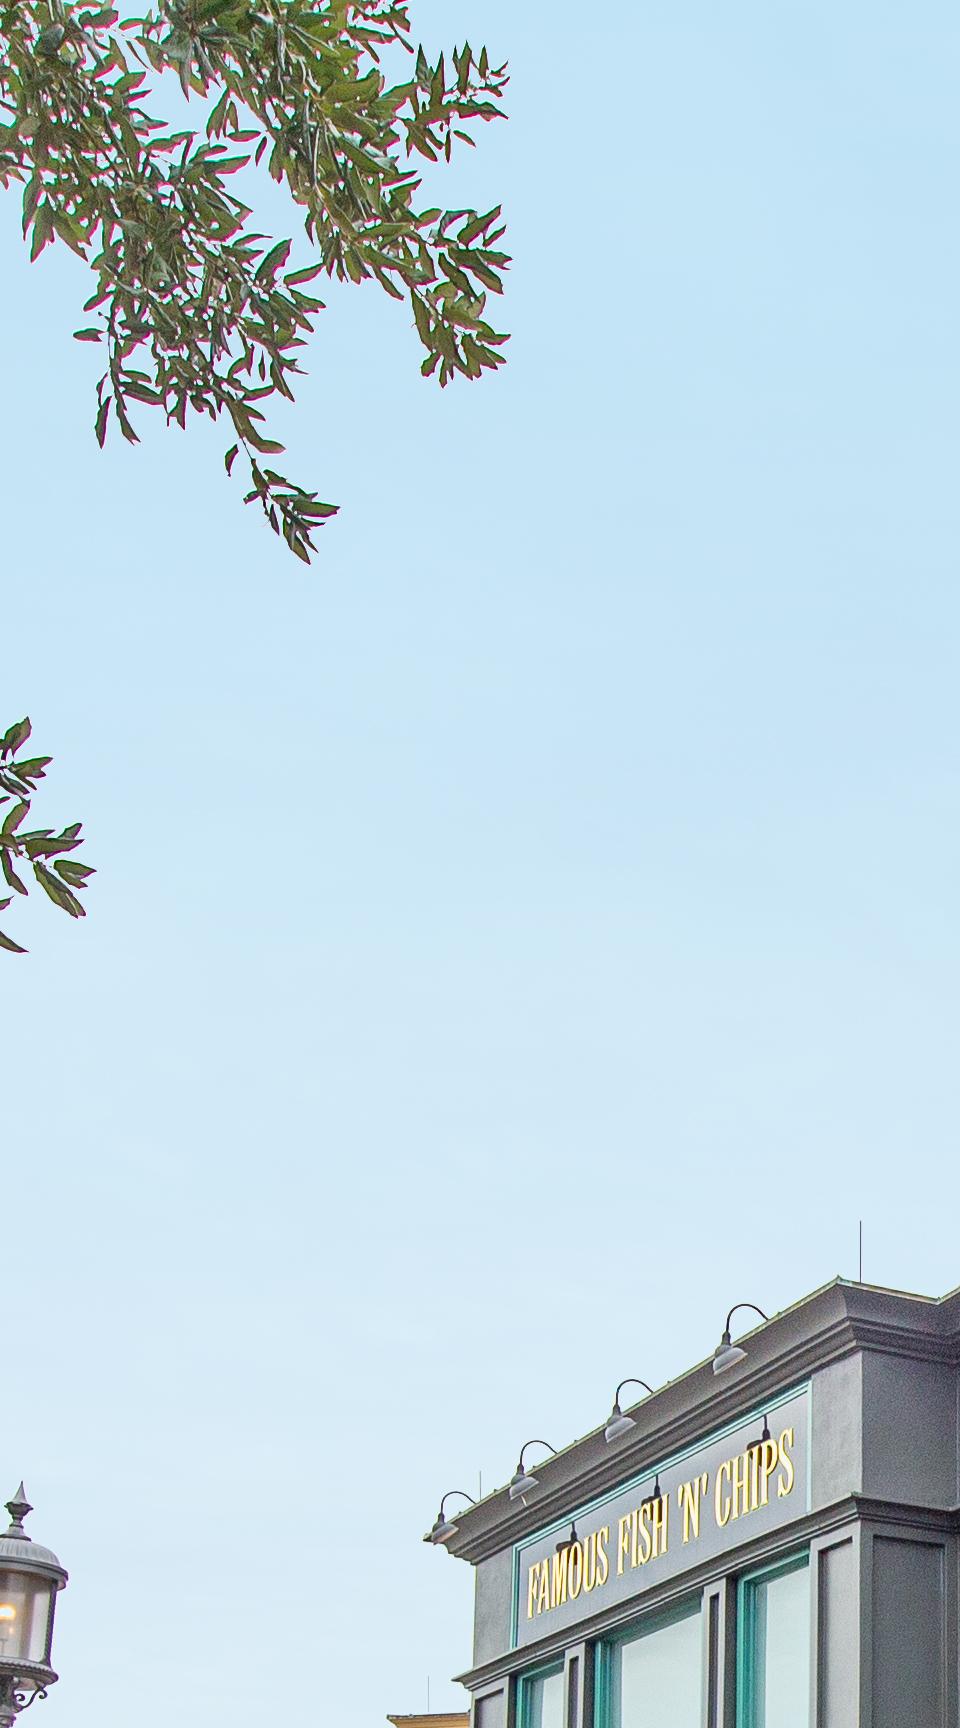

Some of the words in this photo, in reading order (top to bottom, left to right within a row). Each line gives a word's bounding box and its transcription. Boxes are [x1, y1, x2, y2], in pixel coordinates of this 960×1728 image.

[526, 1526, 610, 1619] FAMOUS
[616, 1493, 670, 1576] FISH
[714, 1427, 795, 1528] CHIPS
